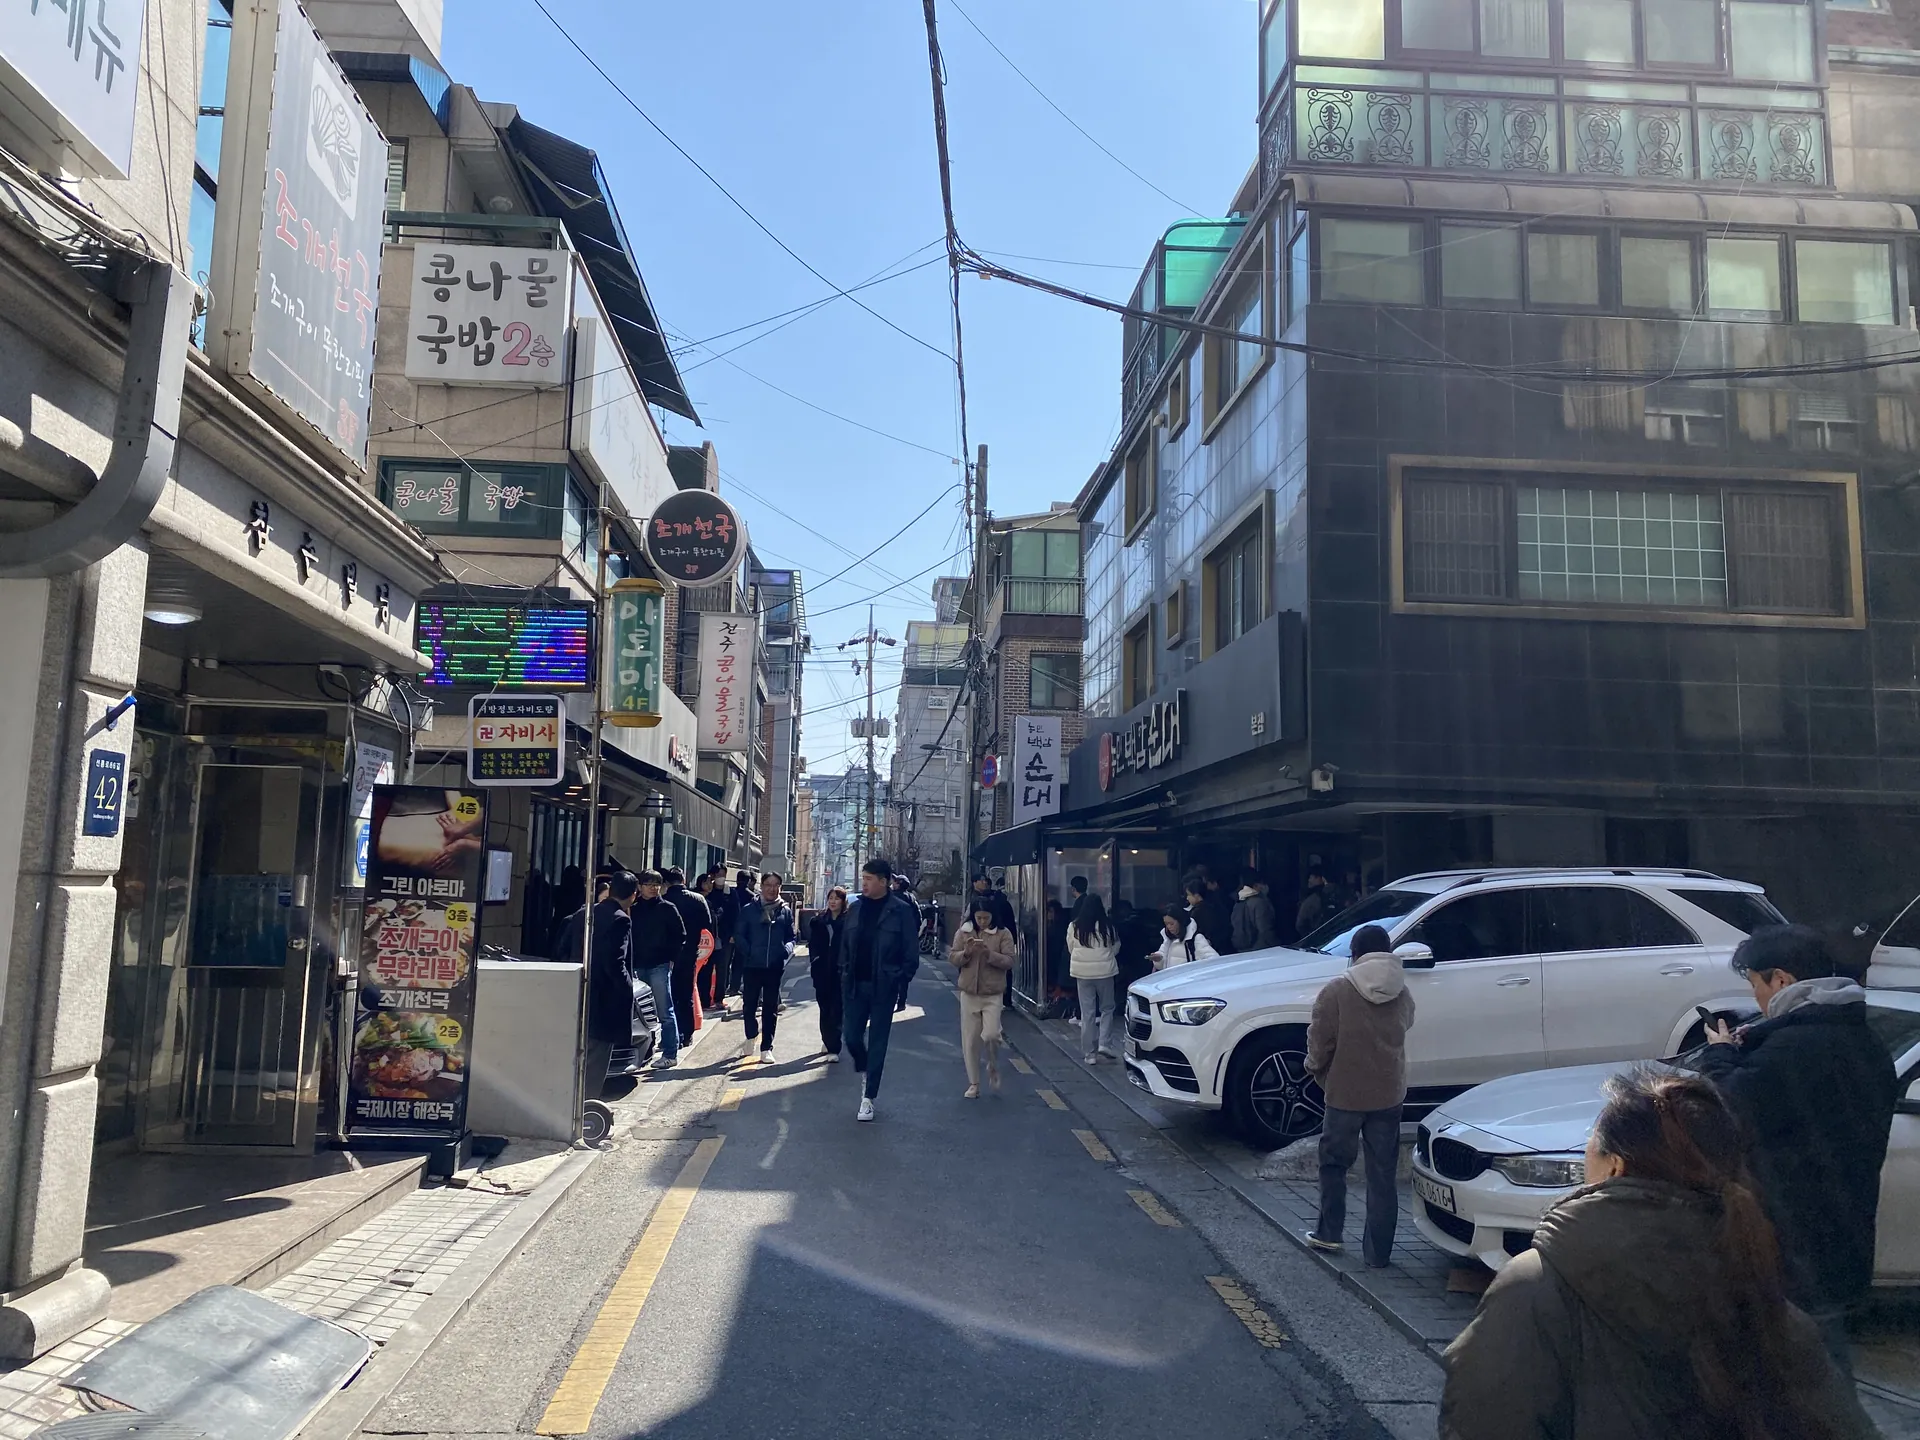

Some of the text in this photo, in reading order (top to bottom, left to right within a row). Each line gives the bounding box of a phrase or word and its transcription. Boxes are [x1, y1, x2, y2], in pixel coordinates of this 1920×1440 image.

[275, 168, 373, 348] 조개천국
[421, 253, 557, 308] 콩나물
[270, 272, 365, 398] 조개구이 무한리필
[417, 314, 555, 368] 국밥 2층
[396, 477, 524, 515] 콩나물 국밥
[655, 513, 733, 543] 조개천국
[659, 547, 689, 556] 조개구이
[620, 597, 658, 691] 아로마
[718, 621, 738, 653] 전주
[480, 704, 554, 714] 서방정토자비도량
[622, 696, 648, 710] 4F
[714, 655, 737, 744] 콩나물국밥
[498, 723, 555, 742] 자비사
[1027, 736, 1052, 749] 백암
[1023, 752, 1054, 807] 순대
[93, 775, 118, 811] 42
[457, 802, 477, 815] 4층
[381, 876, 466, 898] 그린 아로마
[447, 909, 468, 922] 3층
[378, 927, 459, 952] 조개구이
[376, 956, 457, 981] 무한리필
[377, 990, 450, 1010] 조개천국
[439, 1025, 459, 1038] 2층
[356, 1099, 455, 1121] 국제시장 해장국
